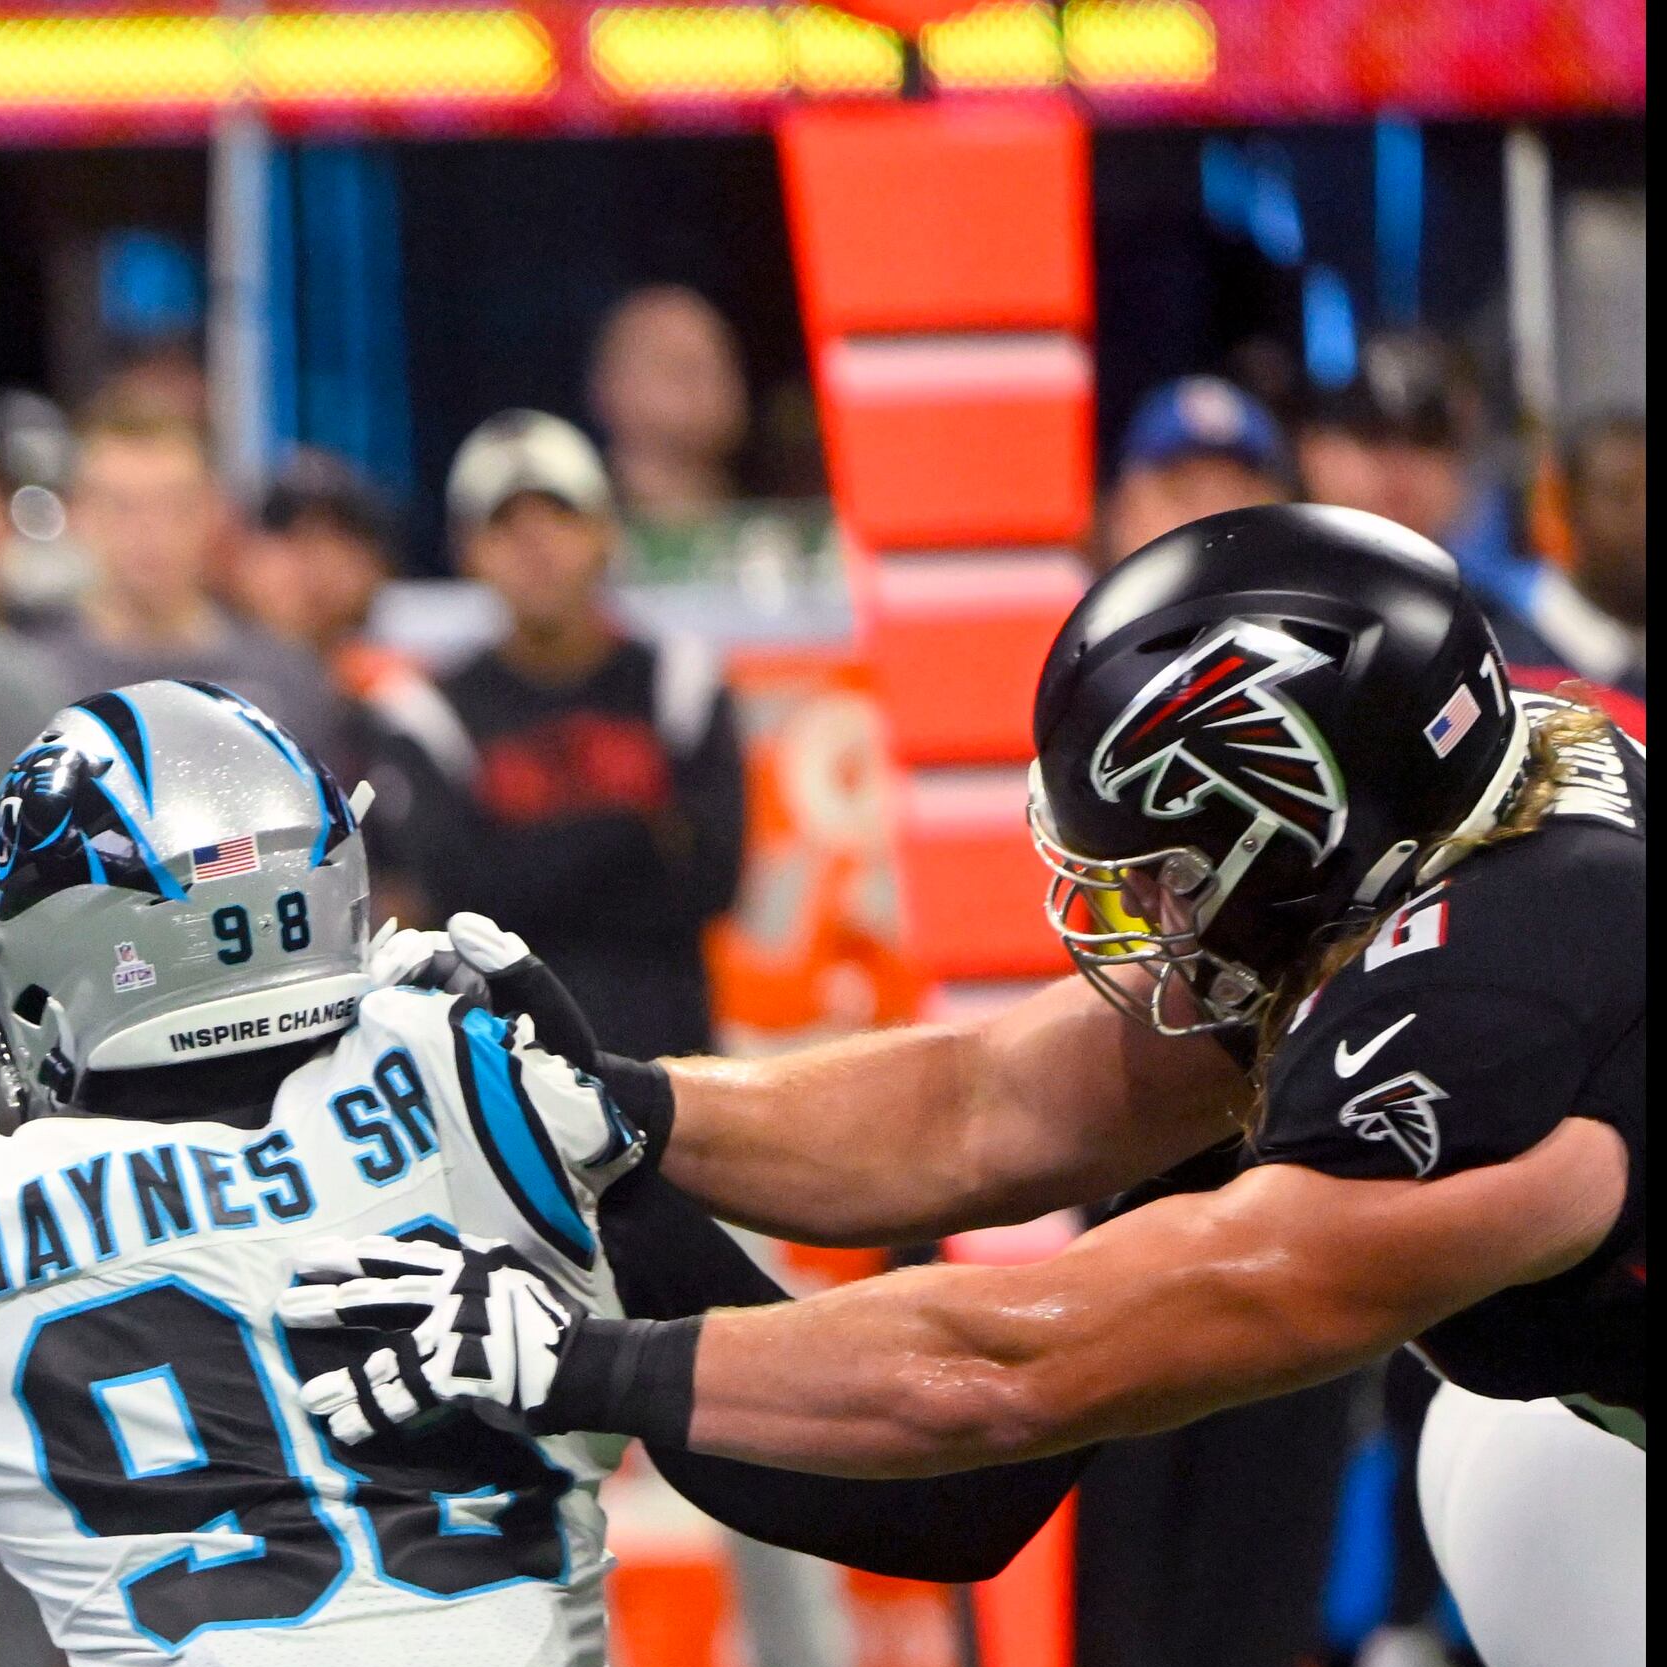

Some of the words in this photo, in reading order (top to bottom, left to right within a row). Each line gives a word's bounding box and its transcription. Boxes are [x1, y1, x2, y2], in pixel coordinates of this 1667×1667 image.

[169, 1016, 271, 1053] INSPIRE
[278, 995, 357, 1034] CHANGE
[325, 1045, 441, 1188] SR
[12, 1212, 574, 1655] 98
